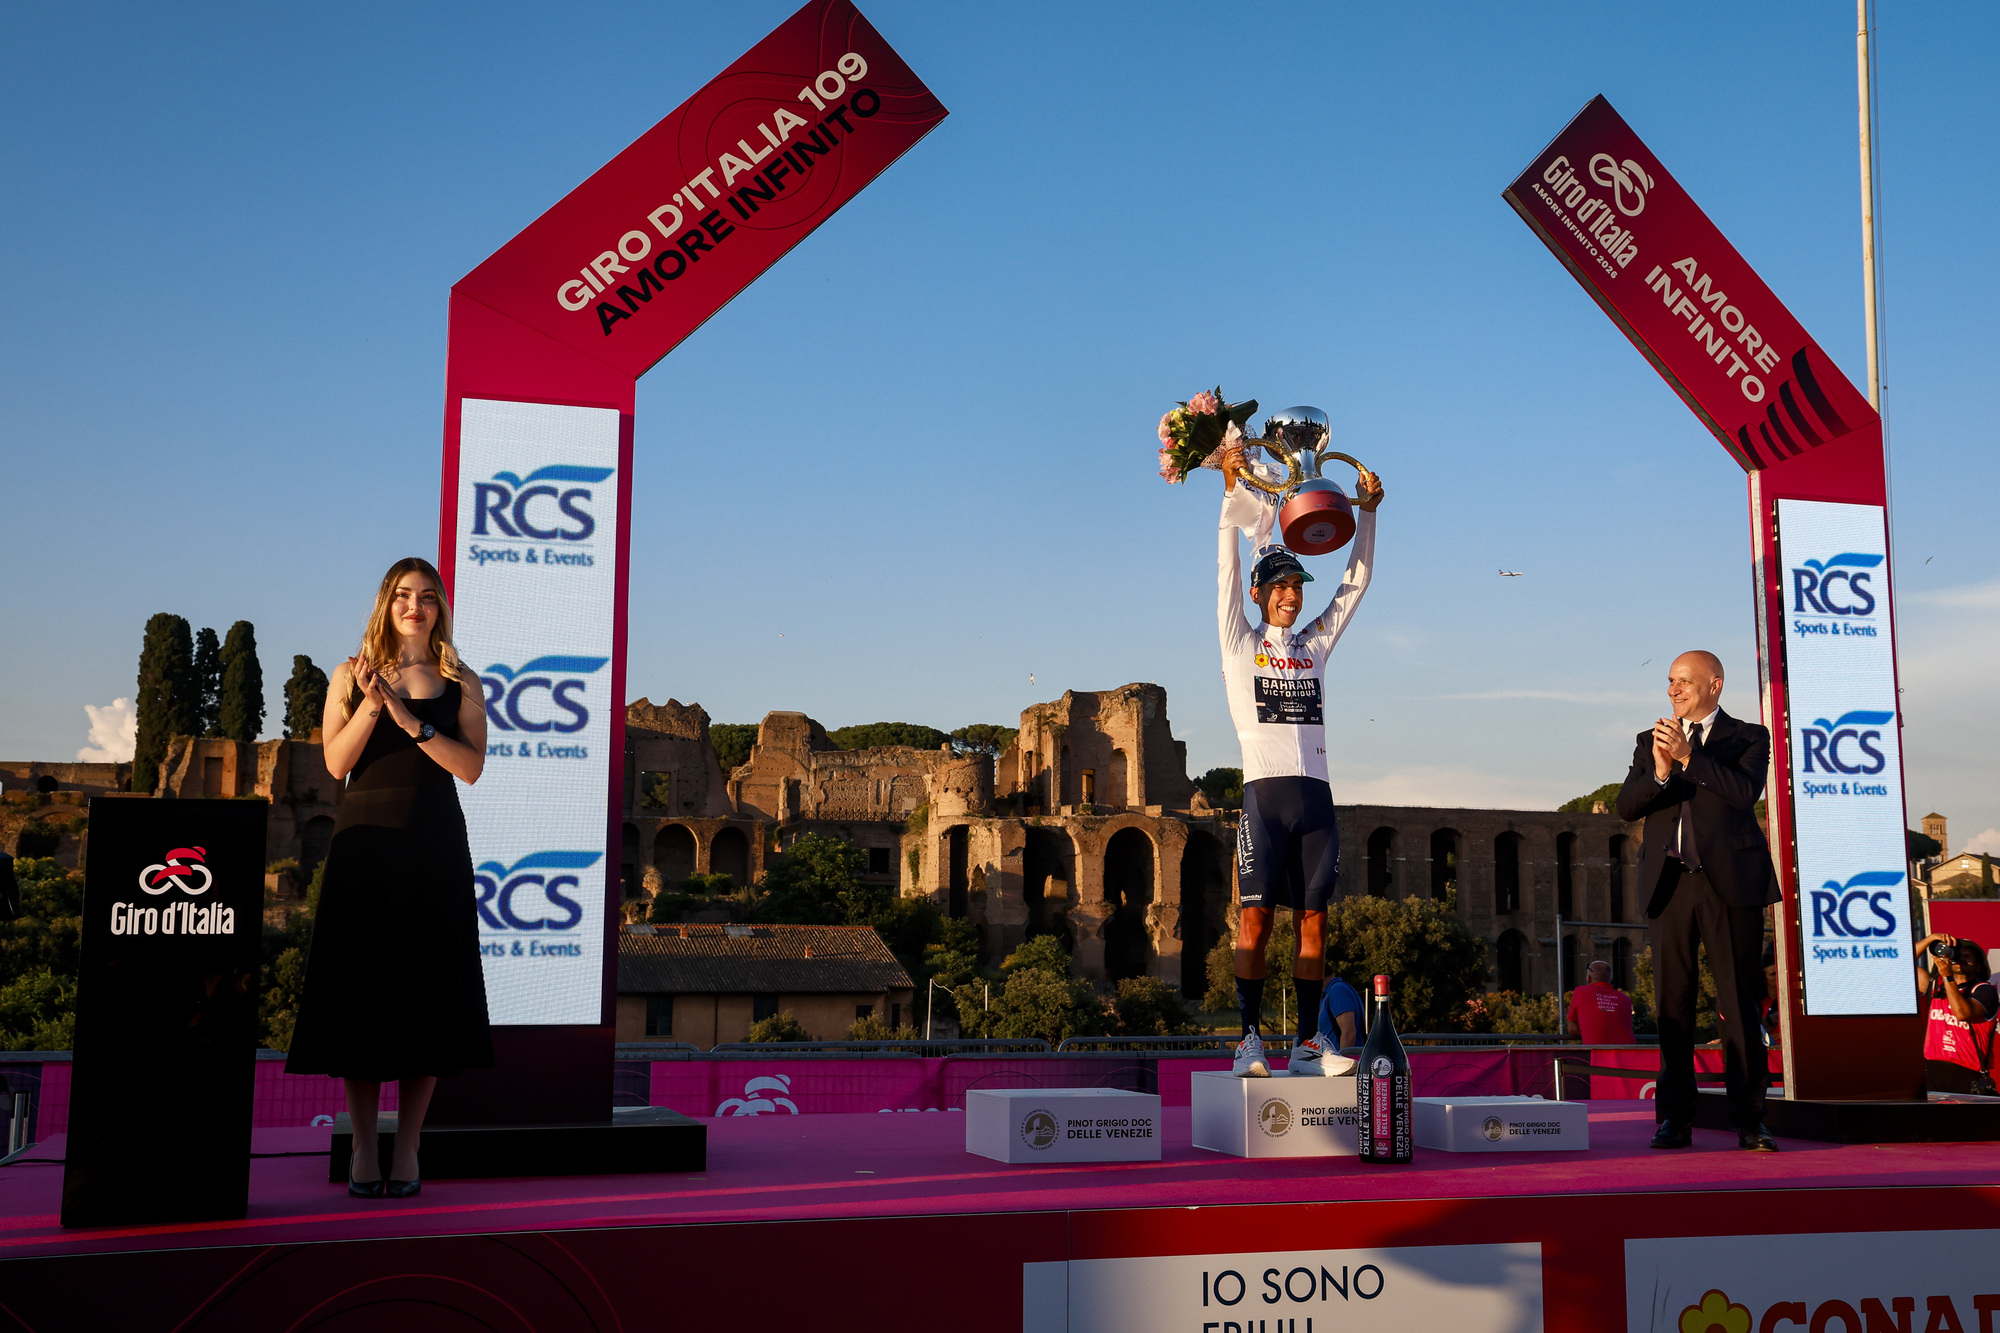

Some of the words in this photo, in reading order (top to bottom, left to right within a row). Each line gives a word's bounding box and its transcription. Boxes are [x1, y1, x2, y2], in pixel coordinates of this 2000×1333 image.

[557, 230, 652, 311] GIRO
[647, 107, 808, 238] D'ITALIA
[797, 52, 868, 112] 109
[596, 208, 736, 336] AMORE
[727, 88, 881, 221] INFINITO
[1543, 155, 1587, 209] Giro
[1577, 198, 1638, 269] d'Italia
[1531, 182, 1564, 217] AMORE
[1560, 214, 1598, 256] INFINITO
[1596, 254, 1618, 279] 2026
[1671, 256, 1781, 375] AMORE
[1644, 264, 1765, 403] INFINITO
[470, 482, 595, 541] RCS
[468, 544, 520, 566] Sports
[525, 547, 538, 564] &
[544, 549, 594, 567] Events
[1791, 568, 1875, 616] RCS
[1793, 620, 1829, 638] Sports
[1831, 621, 1841, 635] &
[1843, 622, 1877, 637] Events
[1270, 656, 1314, 670] CONAD
[1262, 678, 1315, 690] BAHRAIN
[1262, 689, 1317, 698] VICTORIOUS
[485, 743, 513, 757] orts
[518, 741, 532, 757] &
[537, 742, 588, 759] Events
[1800, 728, 1886, 775] RCS
[1802, 781, 1838, 799] Sports
[1841, 781, 1850, 795] &
[1853, 781, 1887, 796] Events
[110, 901, 158, 935] Giro
[161, 901, 235, 935] d'Italia
[1809, 890, 1897, 938] RCS
[510, 940, 524, 957] &
[530, 940, 582, 957] Events
[1812, 944, 1848, 964] Sports
[1851, 945, 1860, 958] &
[1863, 945, 1899, 959] Events
[1395, 1076, 1403, 1109] DELLE
[1067, 1119, 1093, 1128] PINOT
[1096, 1119, 1129, 1127] GRIGIO
[1131, 1118, 1152, 1127] DOC
[1301, 1107, 1326, 1115] PINOT
[1301, 1116, 1334, 1126] DELLE
[1067, 1129, 1102, 1139] DELLE
[1106, 1128, 1153, 1139] VENEZIE
[1396, 1113, 1404, 1158] VENEZIE
[1202, 1269, 1246, 1307] IO
[1262, 1264, 1385, 1305] SONO
